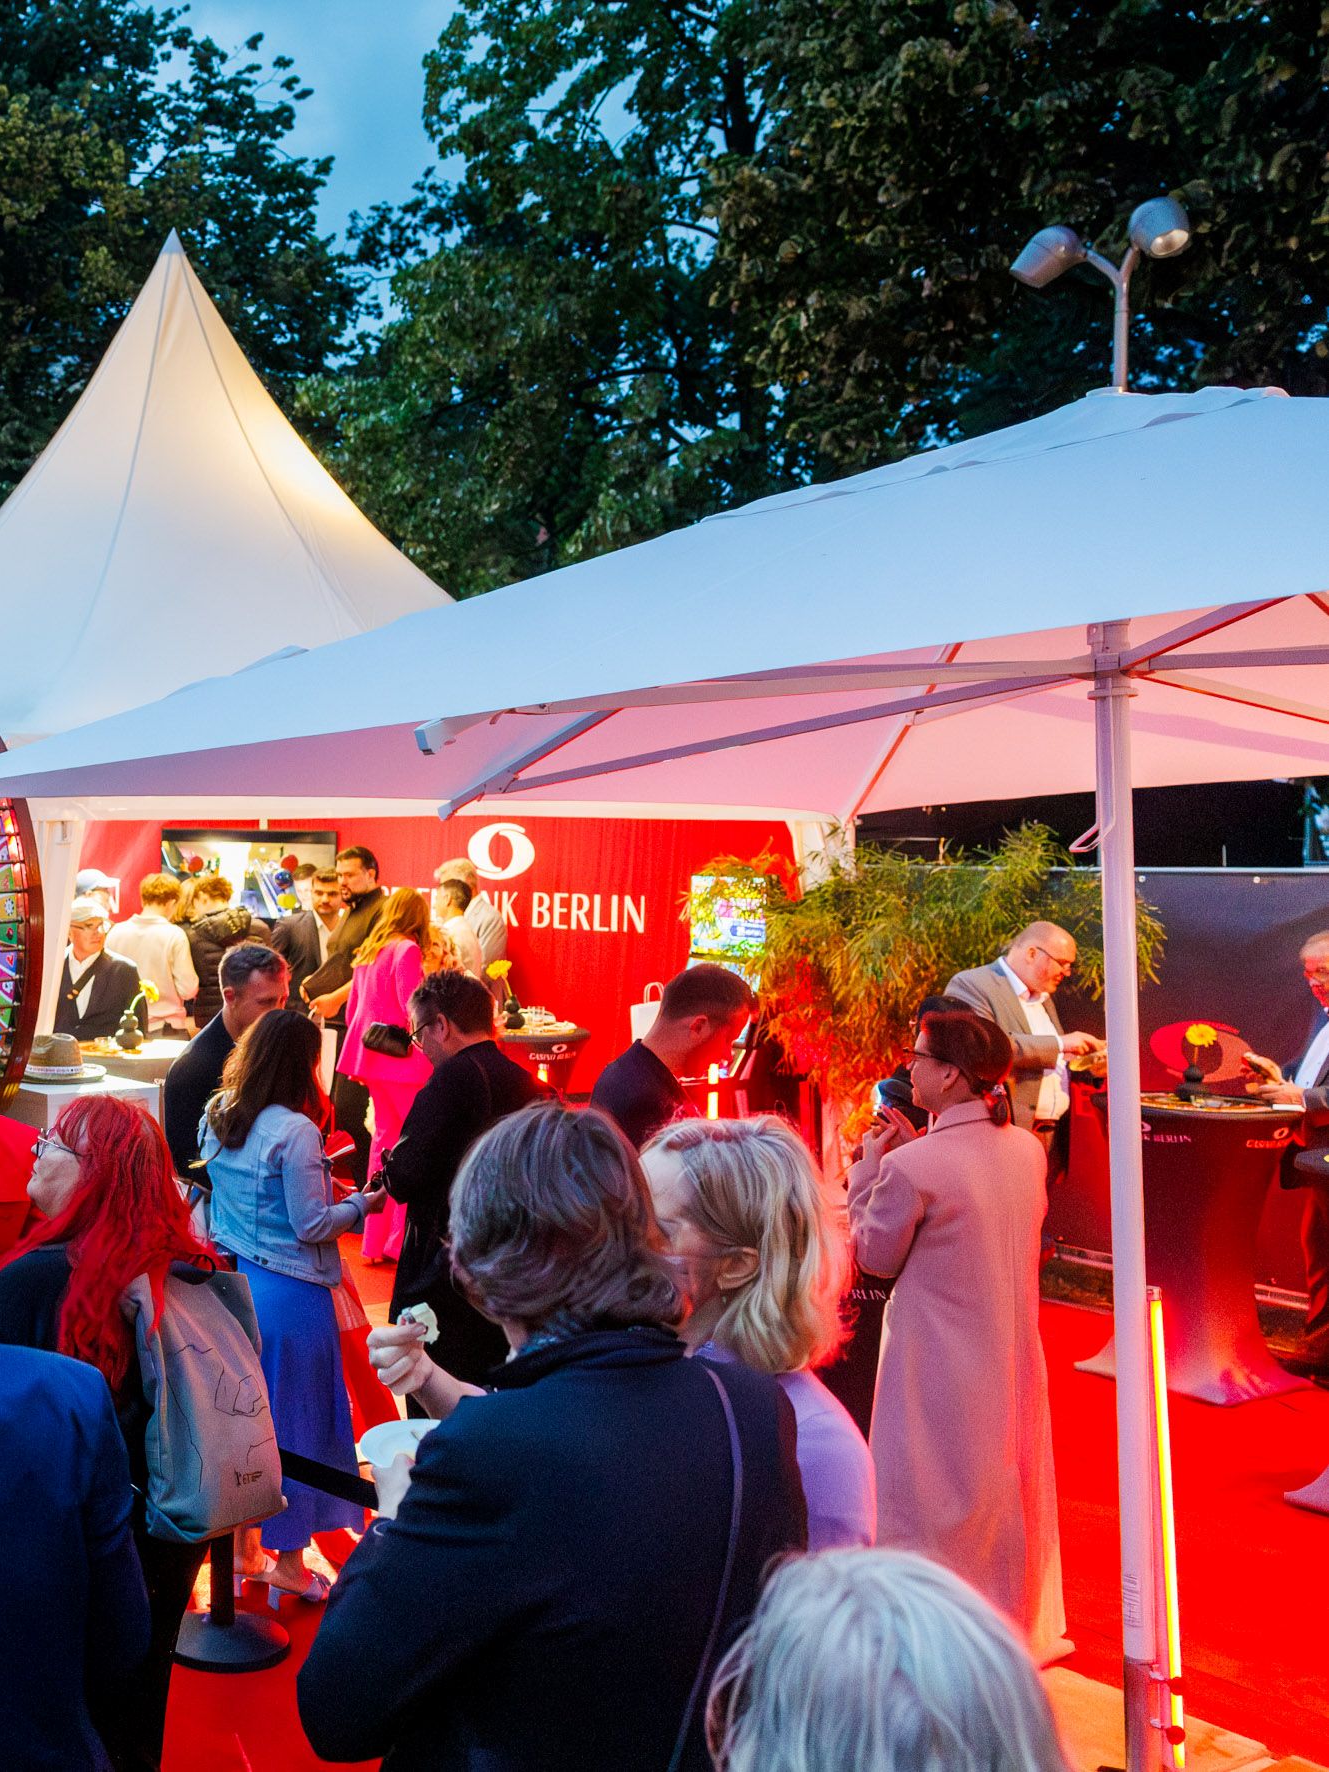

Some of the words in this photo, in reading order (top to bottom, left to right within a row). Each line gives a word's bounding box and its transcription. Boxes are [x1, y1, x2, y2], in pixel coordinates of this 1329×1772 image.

[531, 892, 646, 934] BERLIN
[529, 1052, 556, 1061] CASINO
[851, 1288, 887, 1301] RLIN
